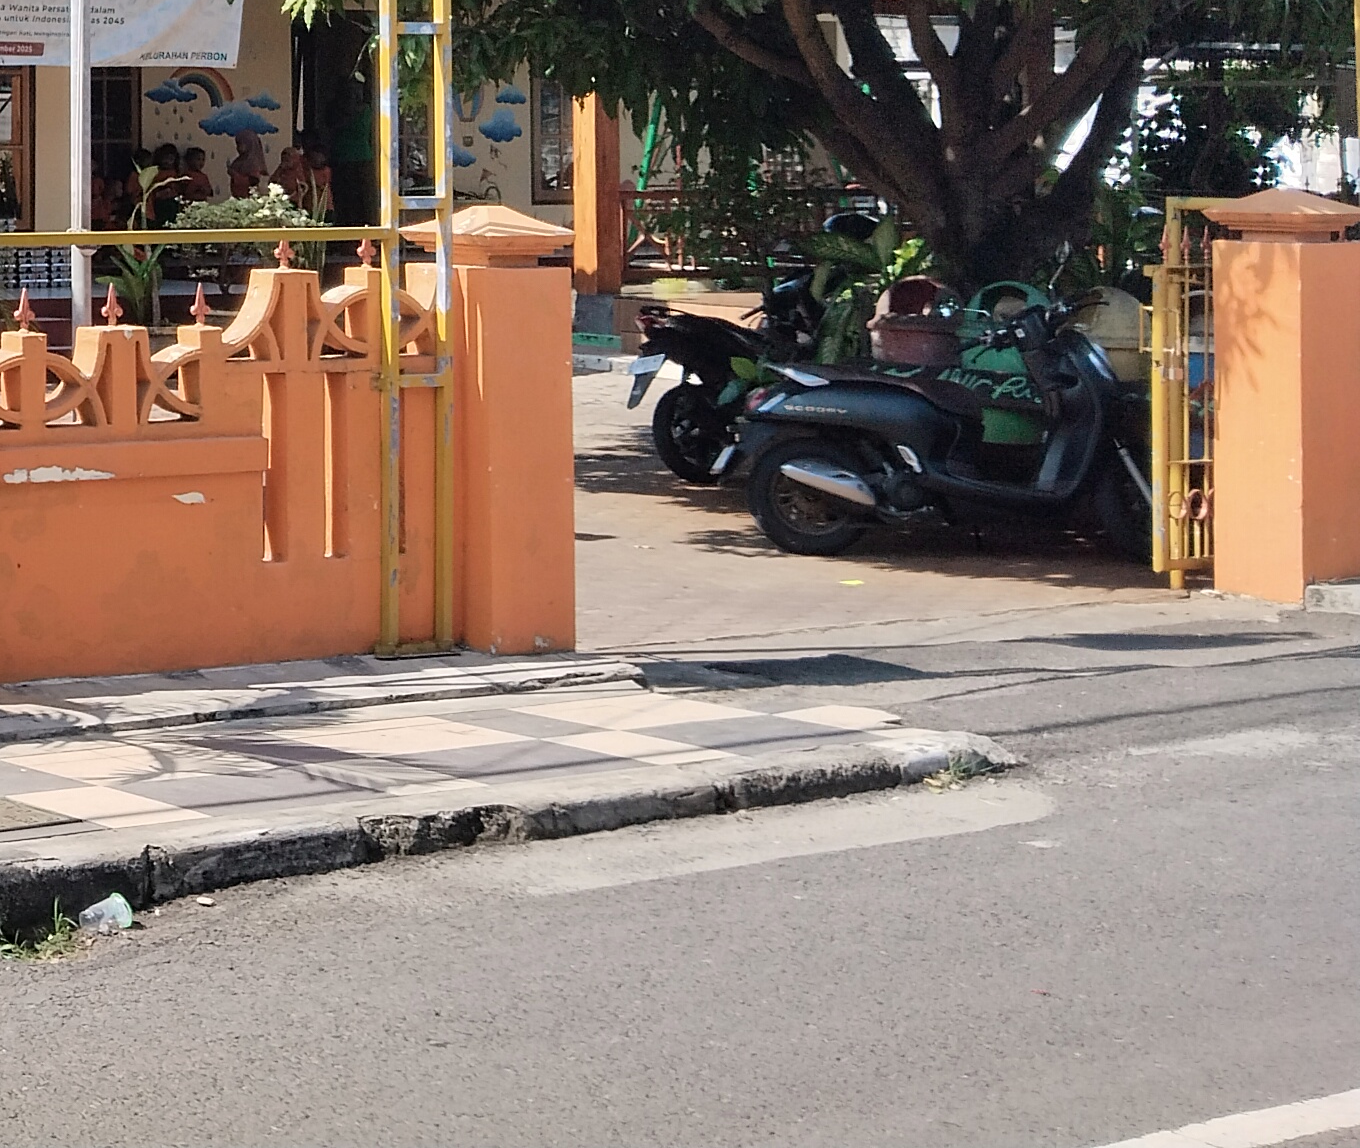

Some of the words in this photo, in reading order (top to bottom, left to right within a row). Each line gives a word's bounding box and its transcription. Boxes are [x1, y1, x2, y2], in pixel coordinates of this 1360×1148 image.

[8, 4, 40, 12] Wanita
[4, 15, 29, 23] untuk
[32, 15, 71, 24] Indonesi
[103, 17, 125, 25] 2045
[190, 52, 227, 61] PERBON
